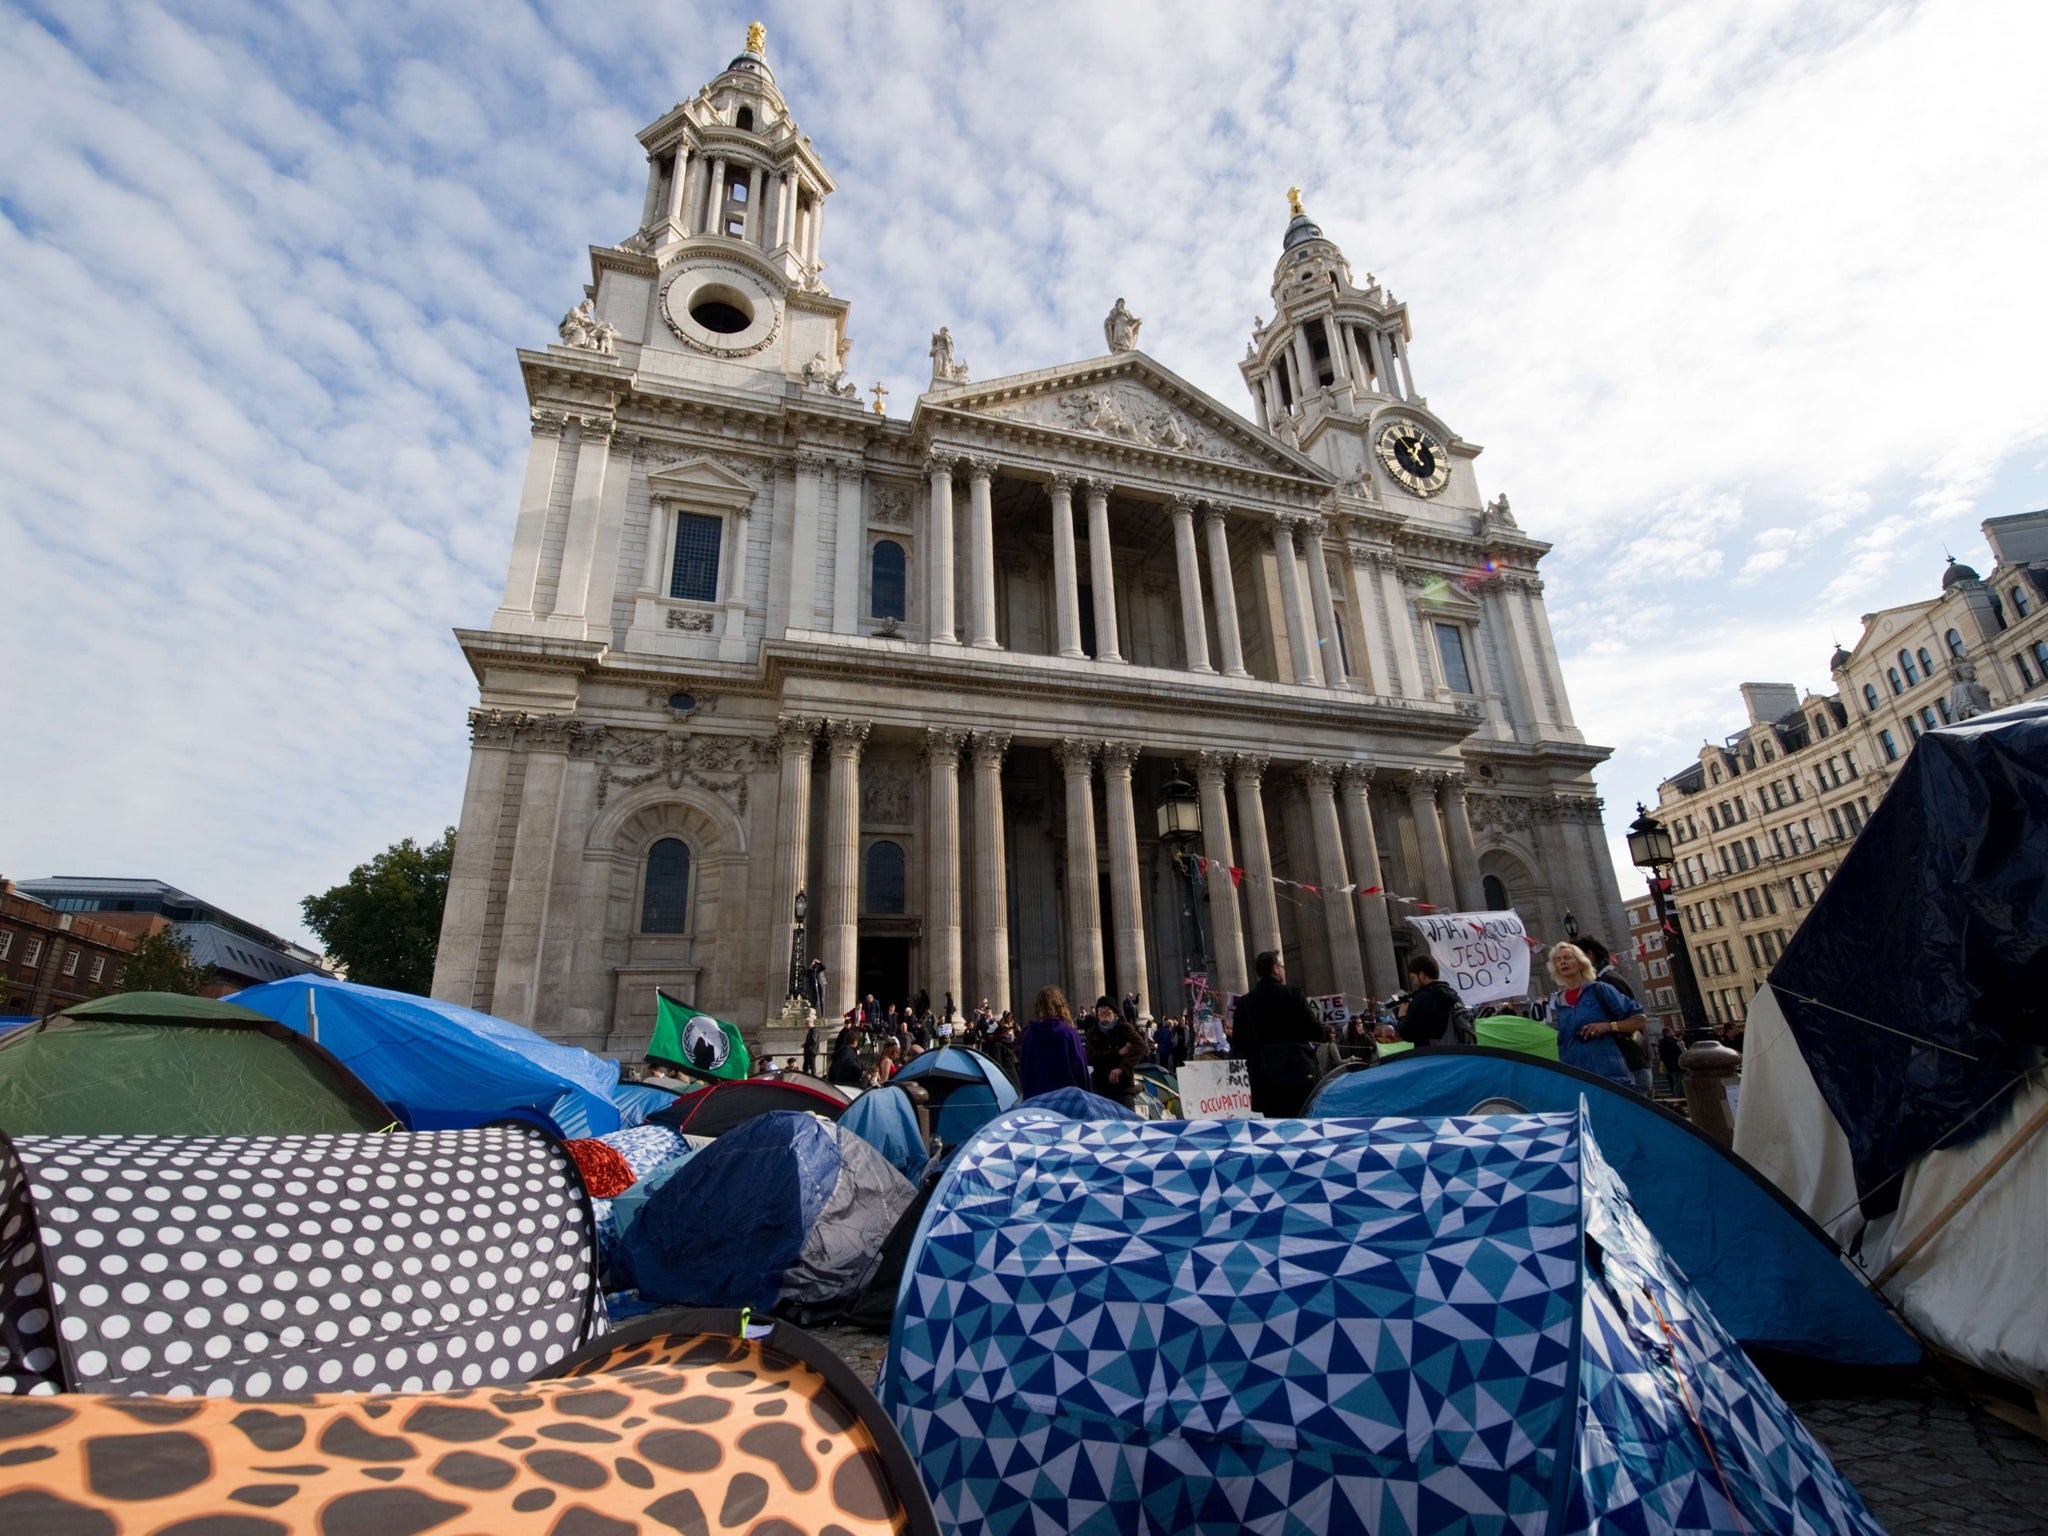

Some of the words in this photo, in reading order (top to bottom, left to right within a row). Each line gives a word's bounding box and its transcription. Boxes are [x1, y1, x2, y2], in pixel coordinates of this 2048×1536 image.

[1418, 917, 1468, 943] WHAT
[1468, 916, 1523, 941] WOULD
[1451, 939, 1511, 968] JESUS
